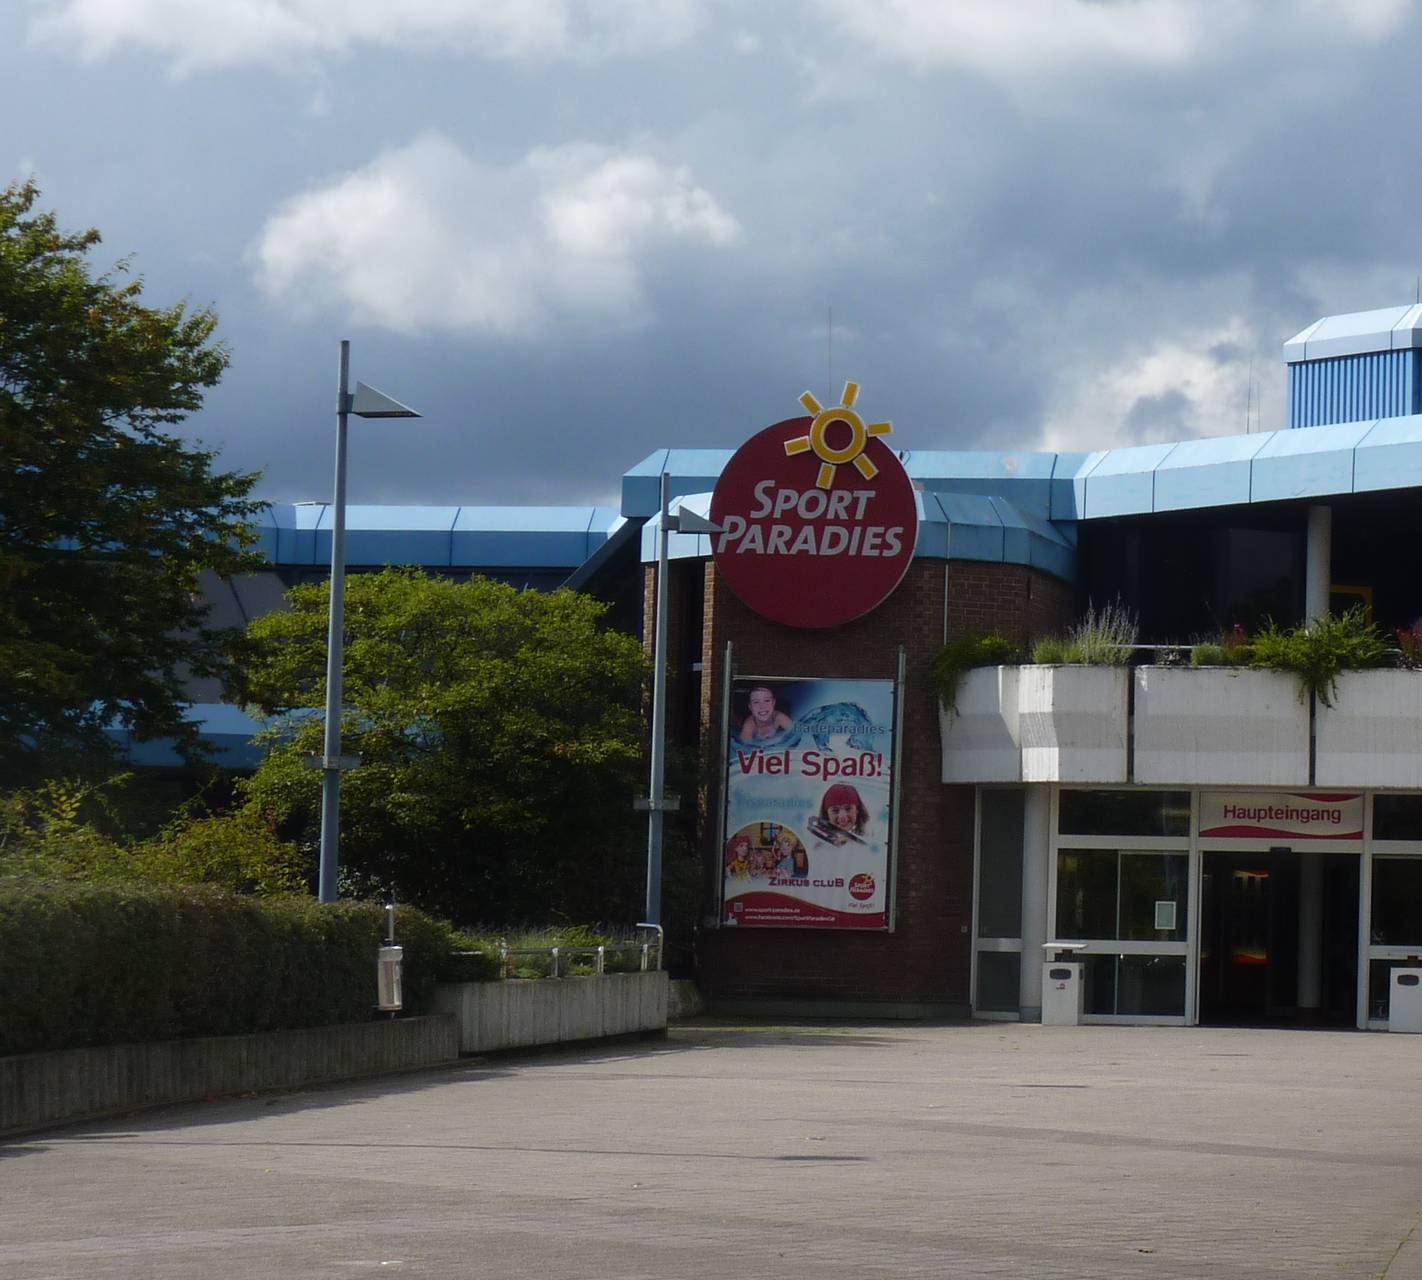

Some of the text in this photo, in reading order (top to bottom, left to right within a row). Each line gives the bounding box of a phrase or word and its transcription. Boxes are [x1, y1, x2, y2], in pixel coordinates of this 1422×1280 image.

[750, 480, 876, 520] SPORT
[717, 515, 904, 557] PARADIES
[737, 750, 883, 782] Viel Spaß!
[1223, 805, 1342, 824] Haupteingang
